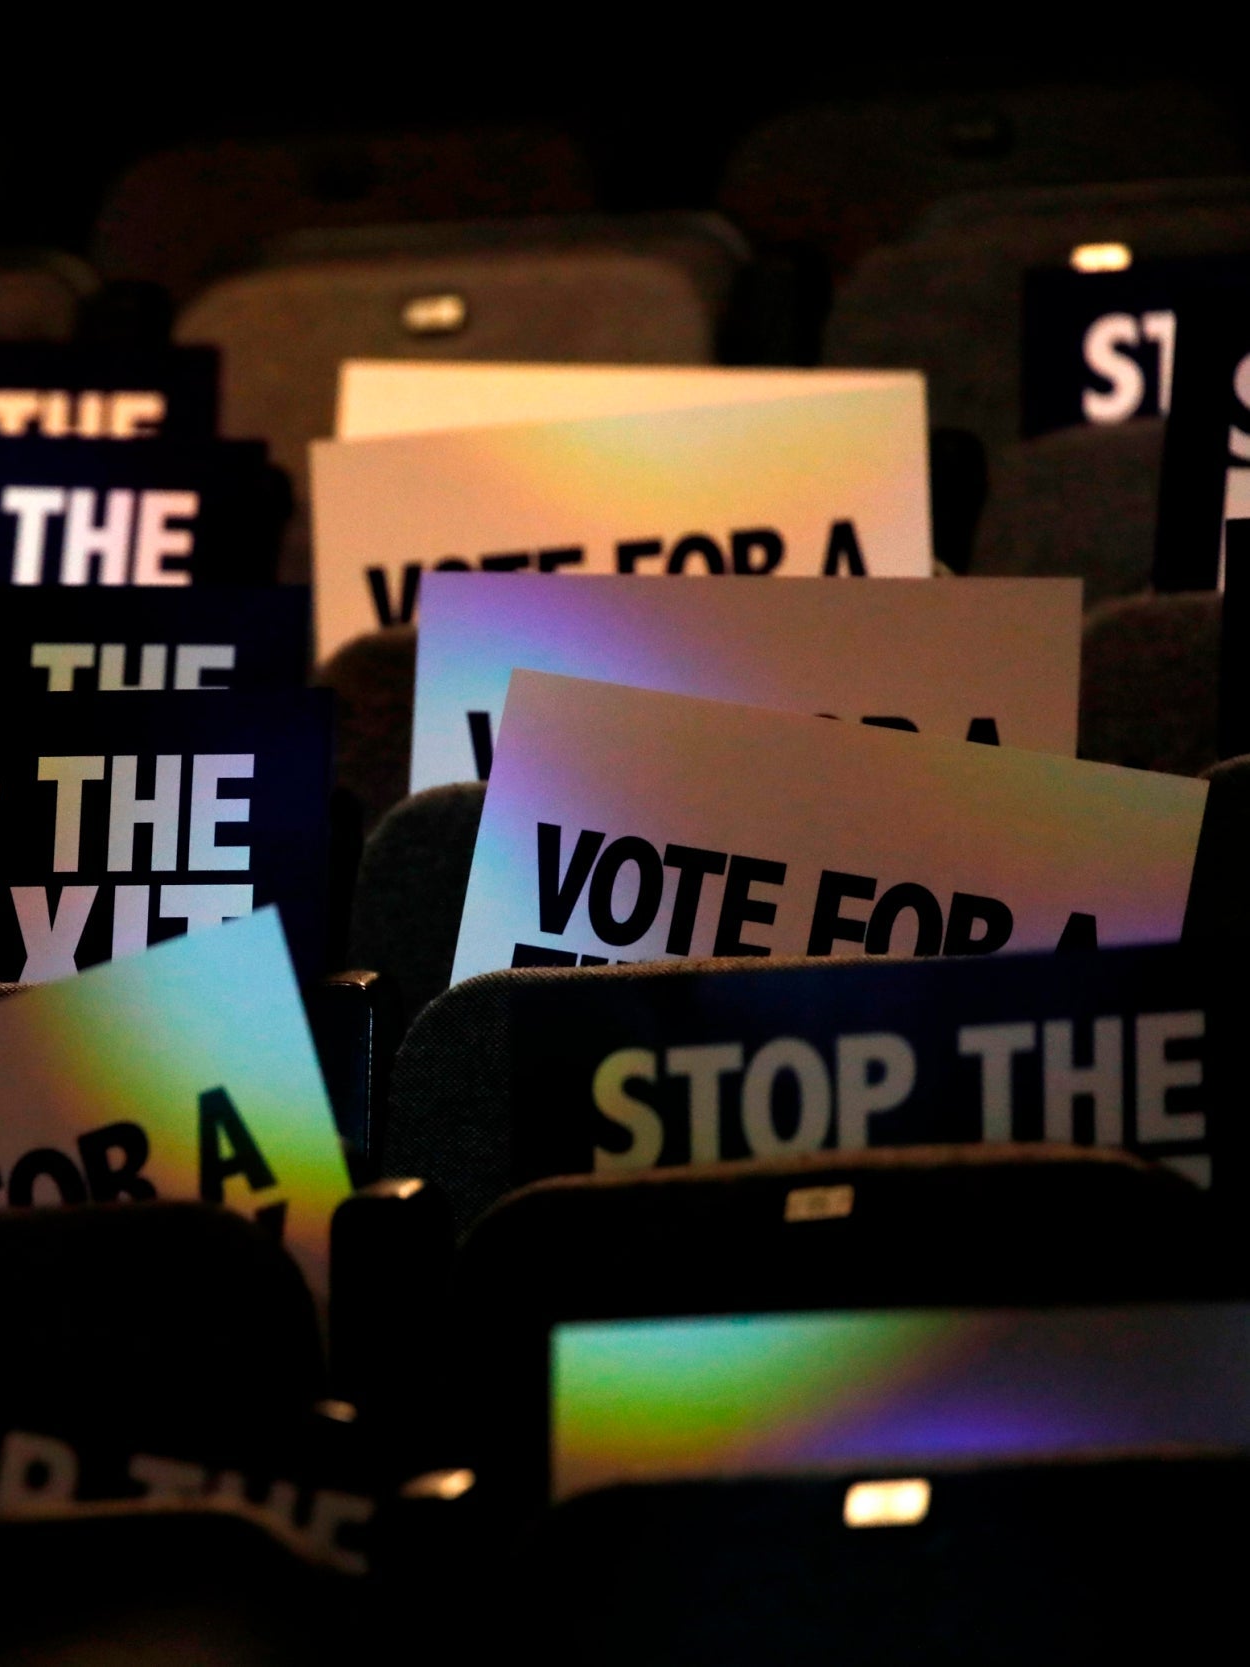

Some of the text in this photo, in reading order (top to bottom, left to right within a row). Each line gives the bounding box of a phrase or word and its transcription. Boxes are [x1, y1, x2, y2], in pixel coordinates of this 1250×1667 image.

[0, 485, 202, 588] THE
[37, 753, 255, 874] THE
[537, 822, 787, 957] VOTE
[591, 1008, 1208, 1177] STOP THE
